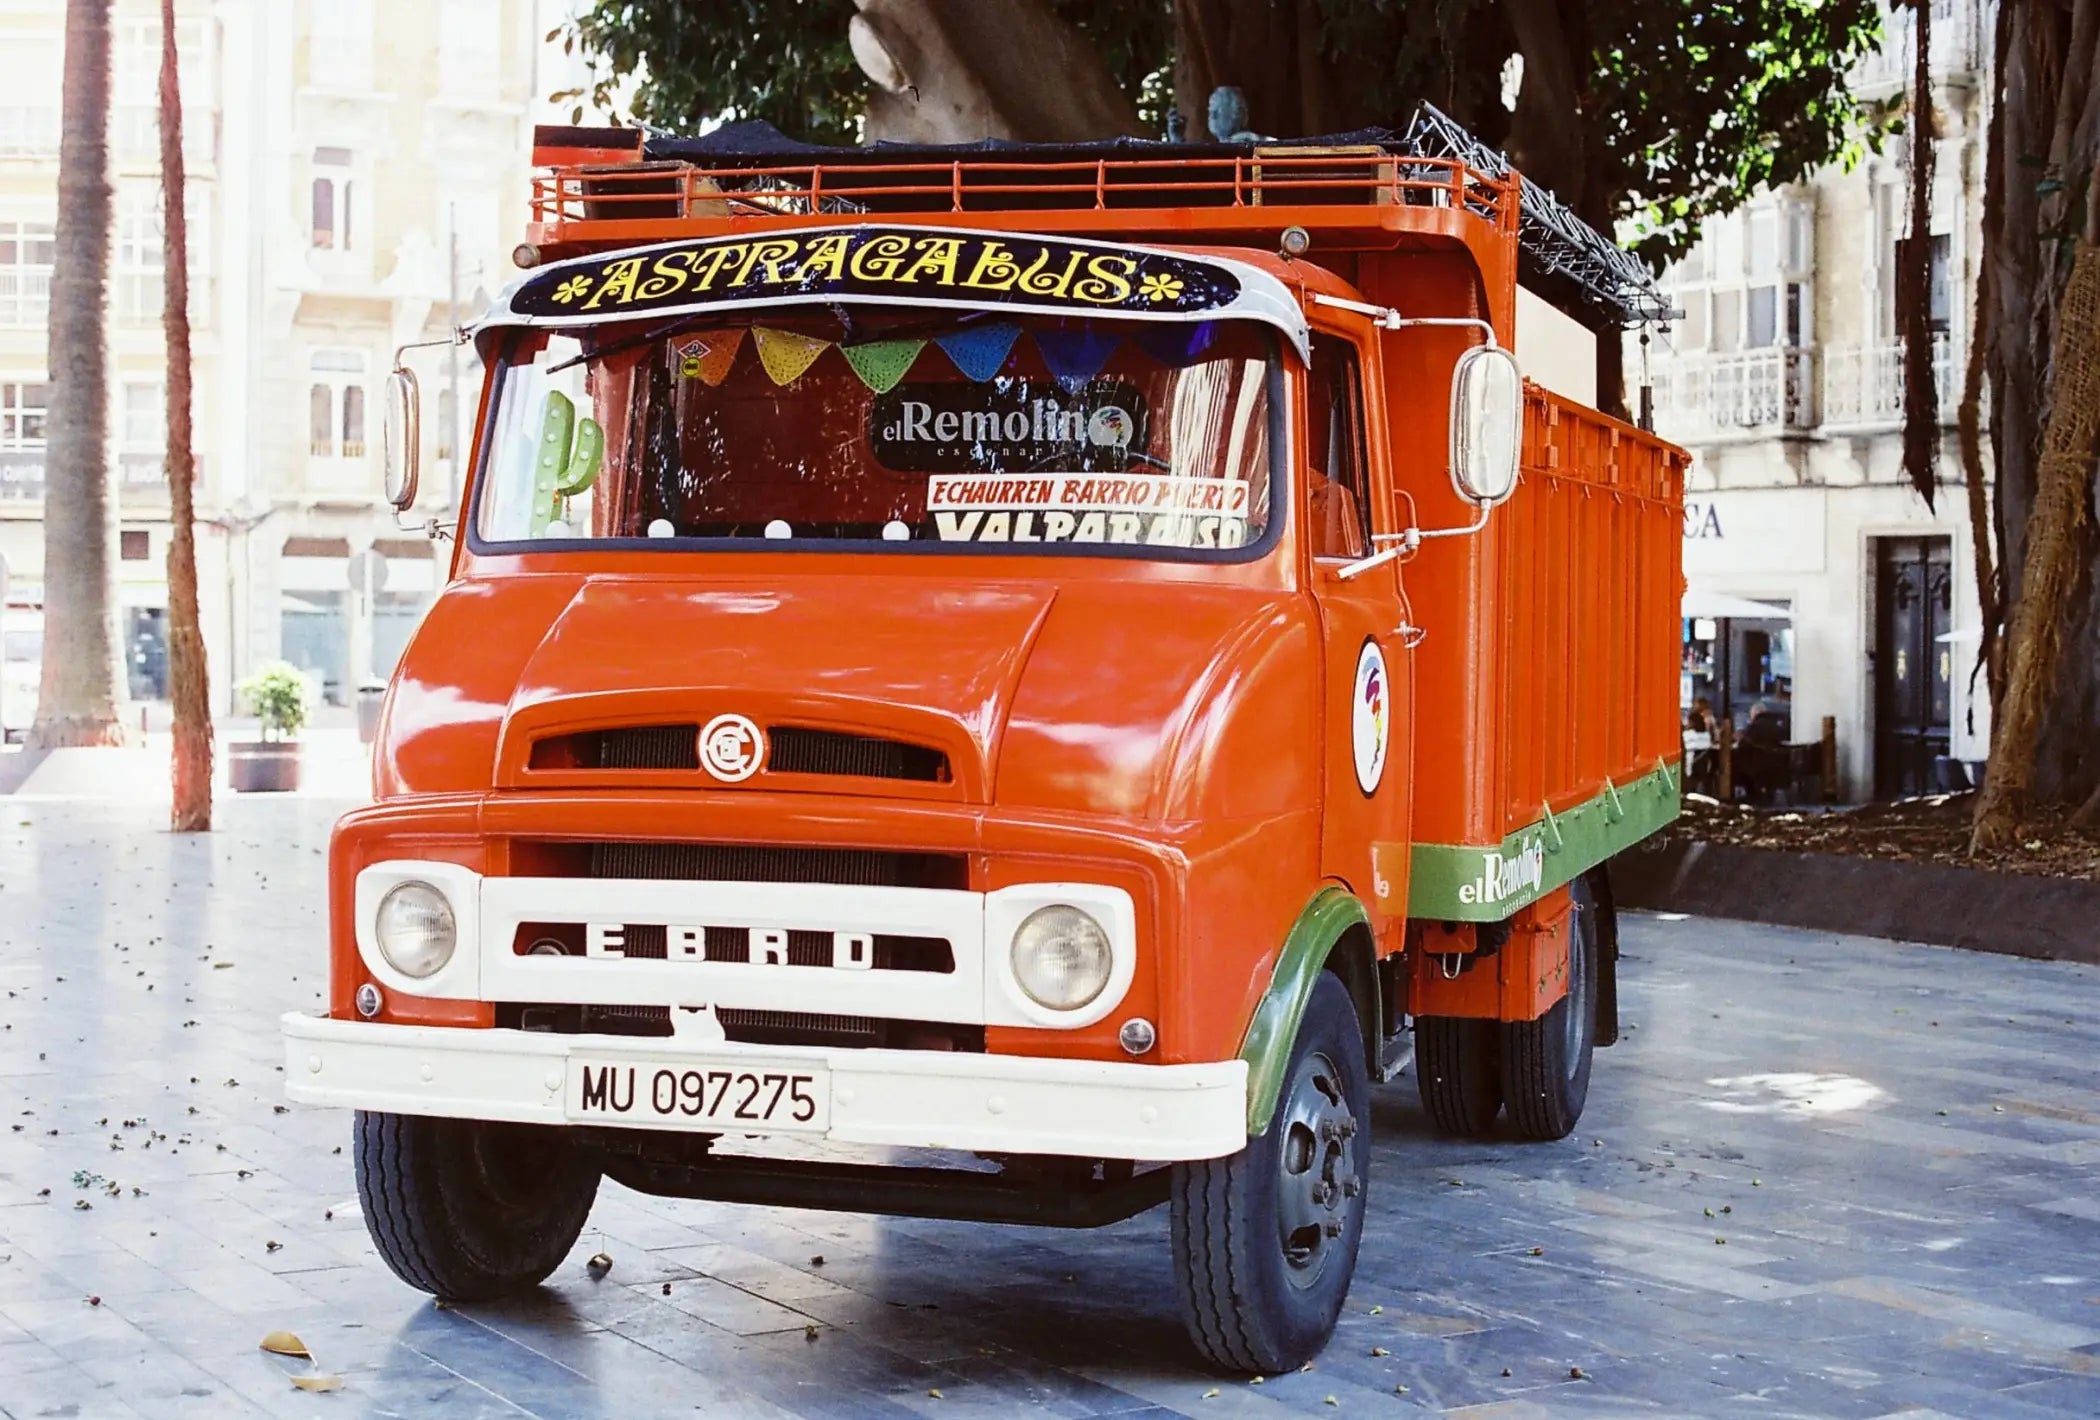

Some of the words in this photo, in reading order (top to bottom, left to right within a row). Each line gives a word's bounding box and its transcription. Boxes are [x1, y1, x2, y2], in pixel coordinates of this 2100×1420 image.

[581, 234, 1137, 309] ASTRAGALUS
[933, 480, 1055, 504] ECHAURREN
[1060, 480, 1150, 506] BARRIO
[586, 923, 874, 970] EBRO
[581, 1065, 635, 1113] MU
[652, 1068, 817, 1122] 097275
